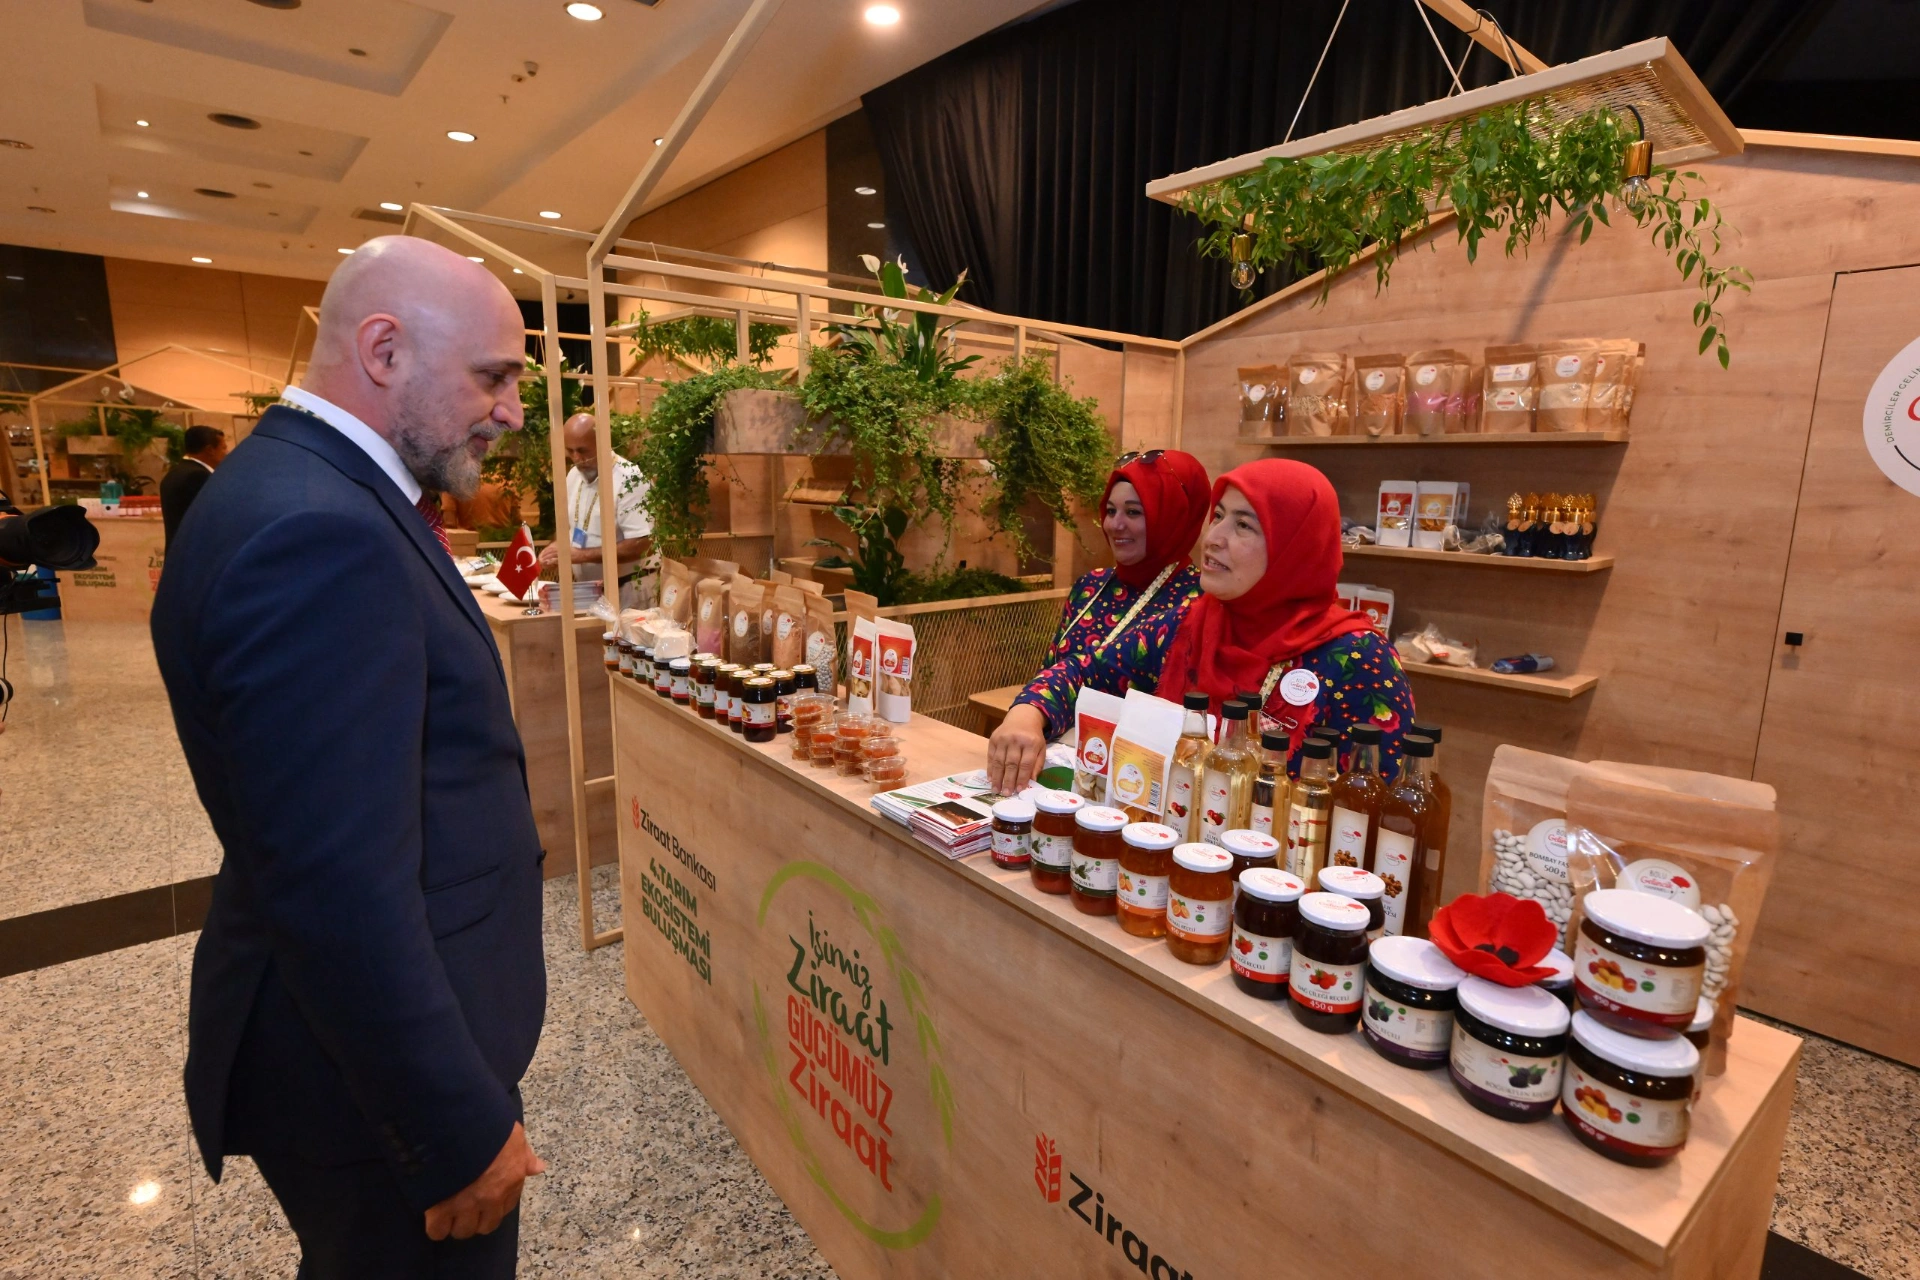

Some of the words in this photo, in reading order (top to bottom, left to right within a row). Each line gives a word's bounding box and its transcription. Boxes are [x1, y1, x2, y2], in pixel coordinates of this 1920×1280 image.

[1883, 390, 1902, 443] DEMİRCİLER
[640, 808, 671, 853] Ziraat
[671, 835, 716, 893] Bankası
[649, 856, 698, 918] 4.TARIM
[1529, 851, 1558, 864] BOMBAY
[1544, 864, 1560, 875] 500
[641, 871, 711, 961] EKOSİSTEMİ
[642, 894, 712, 987] BULUŞMASI
[787, 934, 894, 1067] Ziraat
[808, 909, 873, 1011] İşimiz
[1233, 962, 1245, 975] 450
[1310, 999, 1326, 1010] 450
[1326, 1004, 1333, 1013] g
[787, 994, 893, 1138] GÜCÜMÜZ
[789, 1040, 893, 1194] Ziraat
[1068, 1171, 1194, 1280] Ziraa
